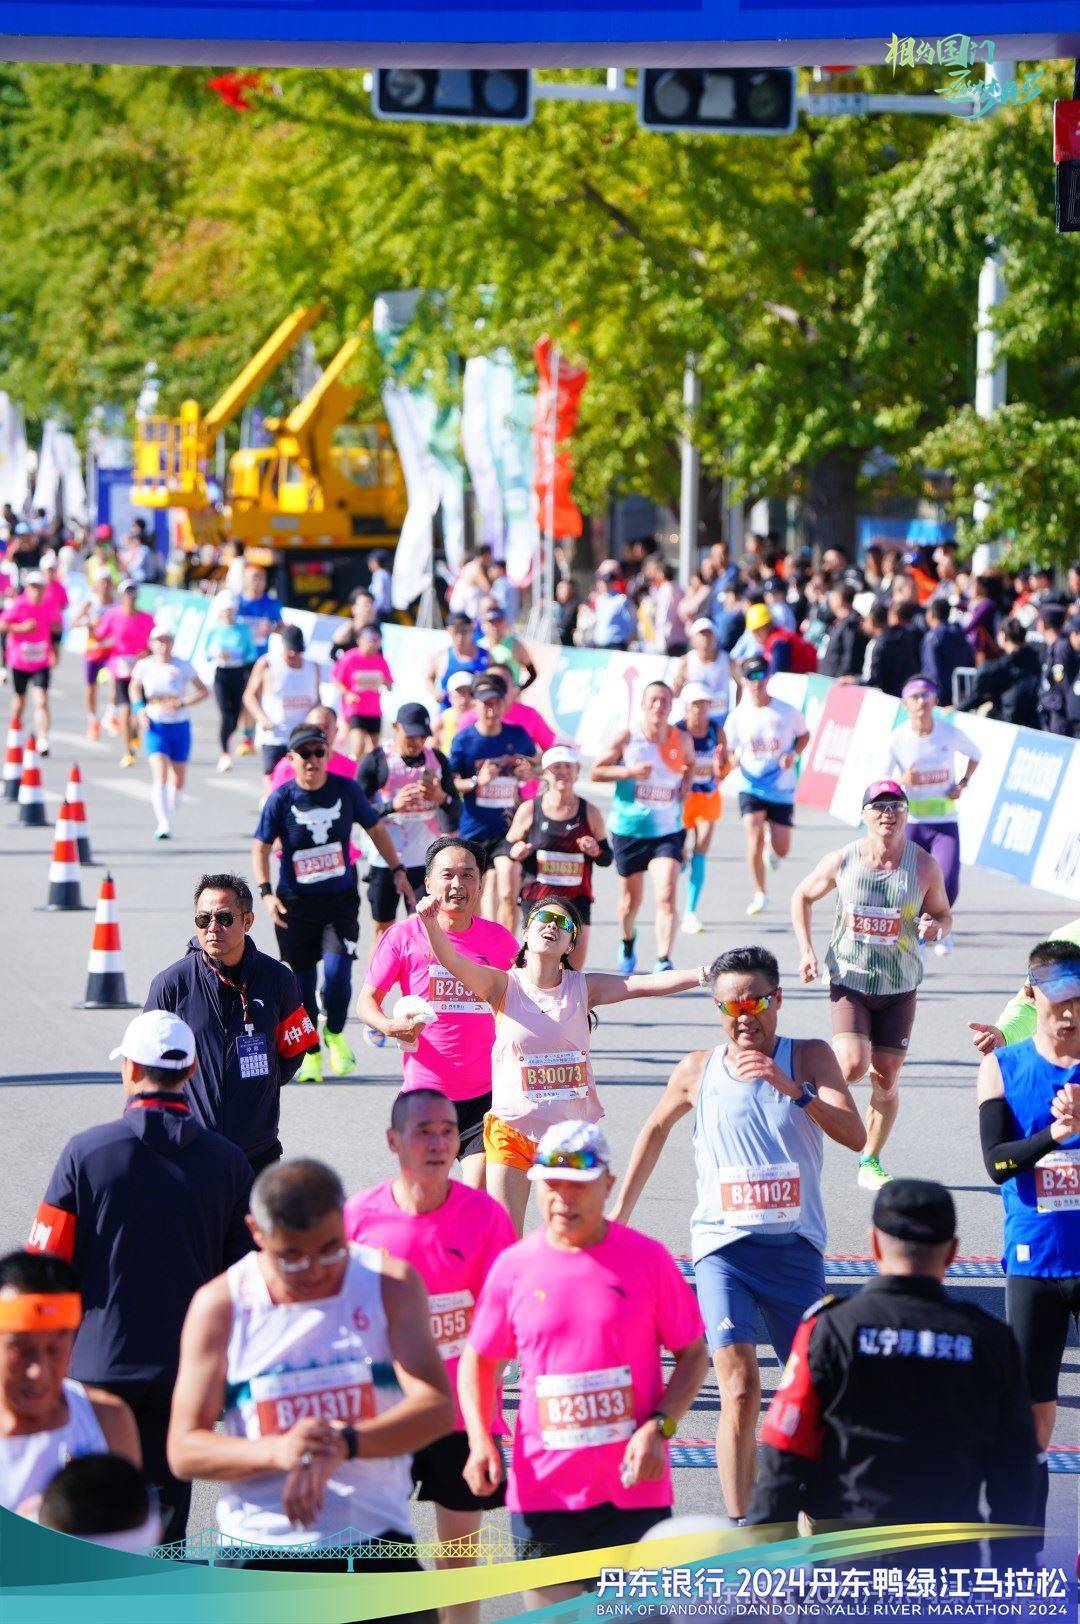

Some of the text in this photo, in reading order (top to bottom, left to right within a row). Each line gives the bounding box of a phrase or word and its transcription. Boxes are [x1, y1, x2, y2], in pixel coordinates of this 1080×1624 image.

[528, 1066, 582, 1085] B30073
[731, 1181, 792, 1205] B21102
[276, 1388, 363, 1429] B21317
[547, 1390, 625, 1423] B23133
